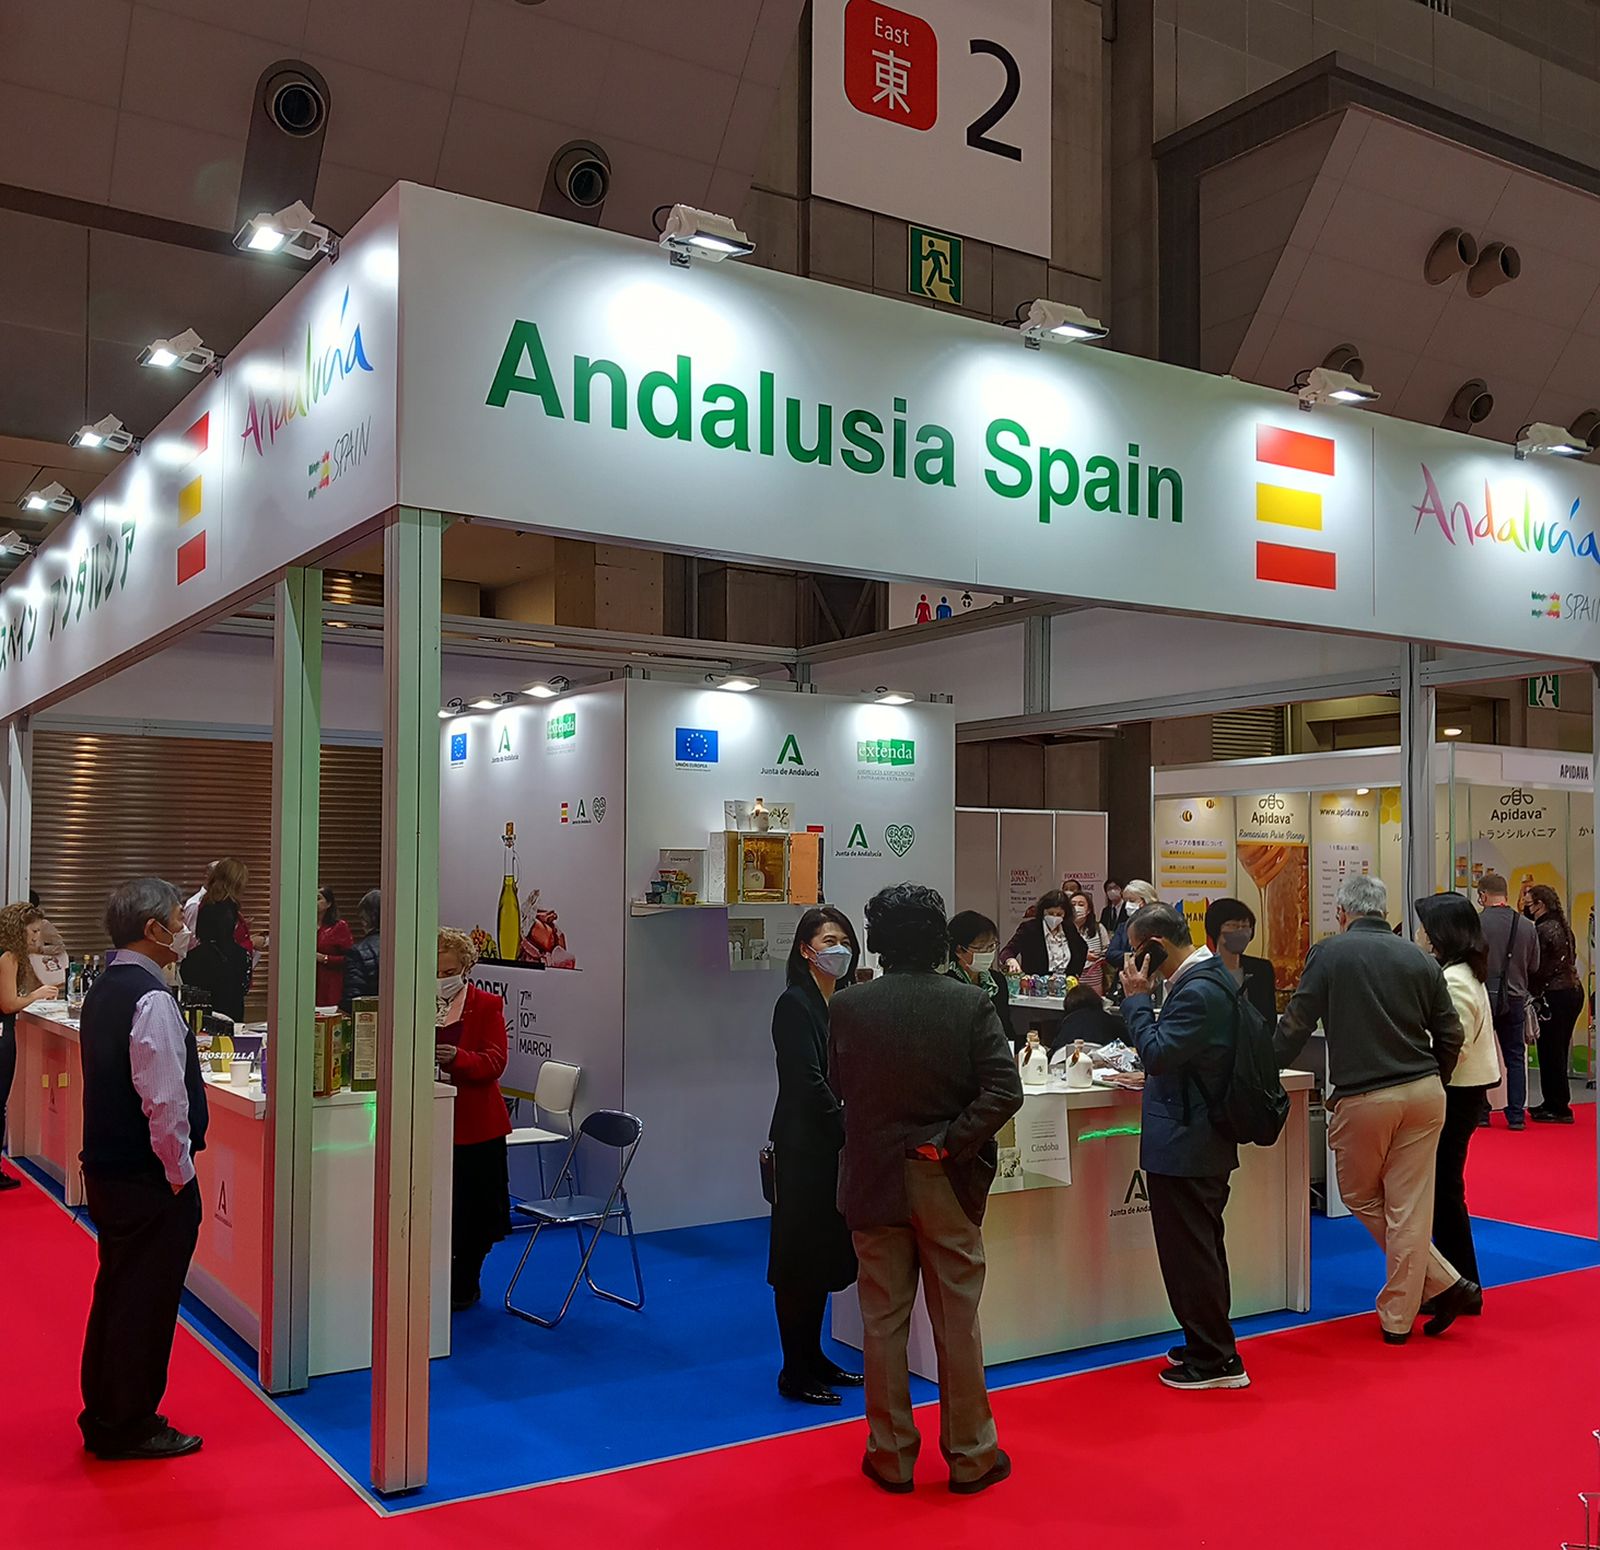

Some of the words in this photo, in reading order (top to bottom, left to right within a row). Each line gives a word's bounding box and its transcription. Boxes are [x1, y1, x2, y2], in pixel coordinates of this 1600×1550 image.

[874, 16, 910, 47] East
[871, 49, 912, 114] 東
[966, 38, 1023, 162] 2
[485, 318, 957, 488] Andalusia
[983, 417, 1185, 525] Spain
[332, 415, 372, 482] SPAIN
[858, 742, 914, 760] extenda
[760, 767, 779, 776] Junta
[789, 767, 820, 777] Andalucía
[1560, 764, 1589, 780] APIDAVA
[1319, 808, 1369, 818] www.apidava.ro
[1478, 827, 1557, 840] トランシルバニア
[835, 850, 850, 858] Junta
[519, 1012, 537, 1029] 10TH
[519, 1039, 552, 1058] MARCH
[1109, 1208, 1127, 1217] Junta
[1127, 1206, 1136, 1215] de
